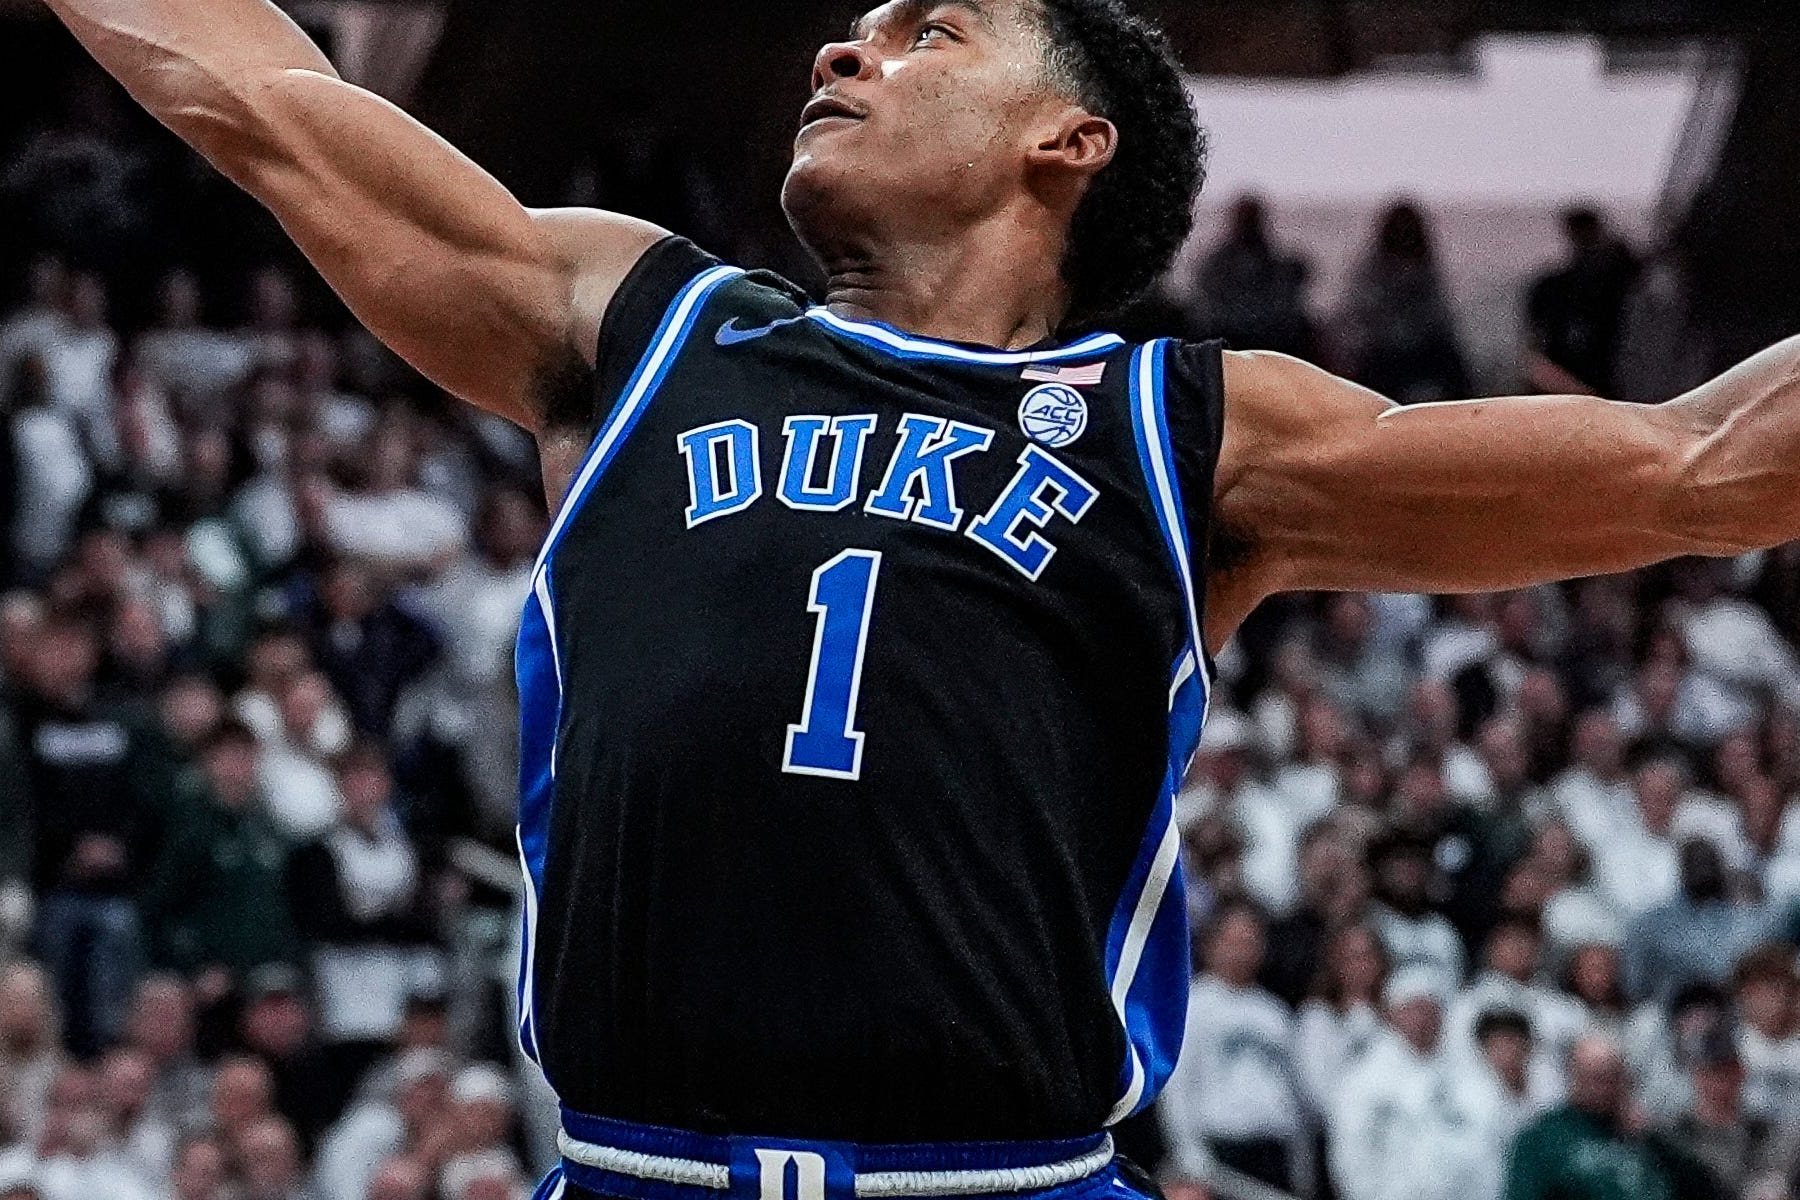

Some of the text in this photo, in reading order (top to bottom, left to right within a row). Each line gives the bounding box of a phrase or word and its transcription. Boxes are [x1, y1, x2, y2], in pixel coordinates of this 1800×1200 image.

[677, 412, 1100, 582] DUKE
[1031, 405, 1082, 423] ACC
[781, 548, 882, 781] 1
